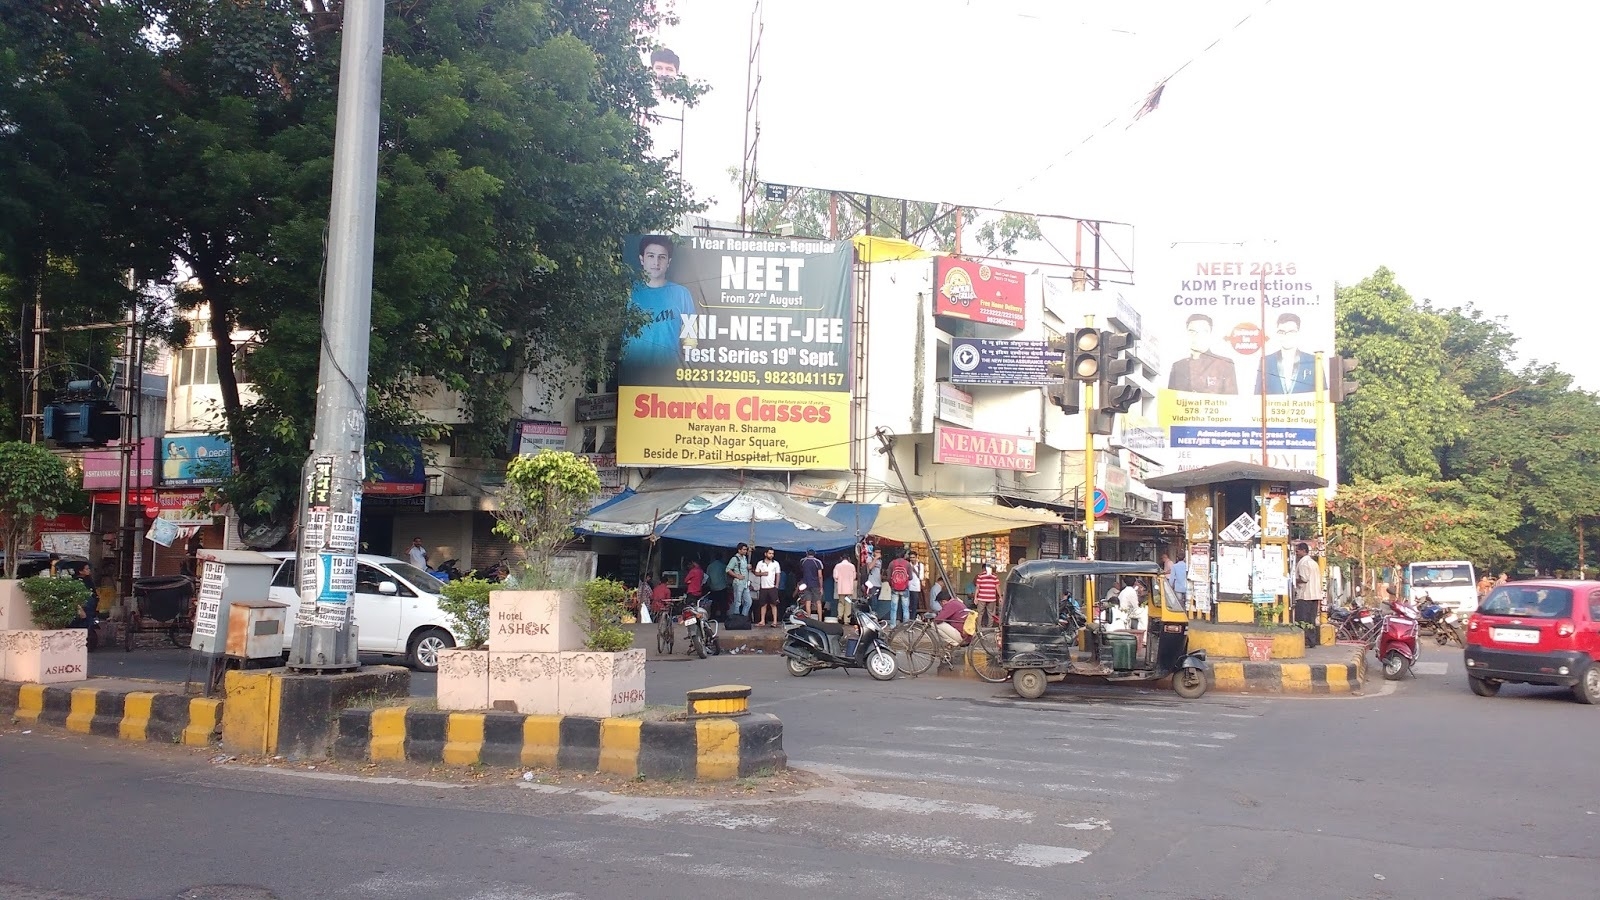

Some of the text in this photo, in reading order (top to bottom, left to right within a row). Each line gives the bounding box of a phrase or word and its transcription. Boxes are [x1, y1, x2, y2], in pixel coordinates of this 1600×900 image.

[691, 237, 836, 254] 1 Year Repeaters-Regular
[720, 256, 805, 292] NEET
[1196, 262, 1297, 276] NEET 2016
[1182, 280, 1313, 291] KDM Predictions
[721, 292, 803, 308] From 22nd August
[1173, 294, 1218, 306] Come
[1223, 294, 1256, 305] True
[1005, 304, 1022, 314] Delivery
[680, 314, 843, 344] XII-NEET-JEE
[683, 346, 838, 368] Test Series 19th Sept.
[675, 368, 844, 386] 9823132905, 9823041157
[634, 394, 832, 424] Sharda Classes
[523, 425, 567, 434] PATHOLOGY LABORATORY
[688, 422, 776, 434] Narayan R. Sharma
[675, 434, 788, 449] Pratap Nagar Square,
[942, 433, 1014, 456] NEMAD
[1212, 438, 1241, 446] Regular
[209, 447, 229, 458] pepsi
[643, 448, 678, 460] Beside
[725, 450, 773, 464] Hospital,
[776, 452, 819, 465] Nagpur.
[975, 454, 1032, 470] FINANCE
[85, 470, 121, 478] ASHTAVINAYAK
[334, 514, 357, 524] TO-LET
[206, 564, 224, 573] TO-LET
[333, 558, 354, 567] TO-LET
[200, 602, 218, 612] TO-LET
[498, 611, 522, 621] Hotel
[498, 622, 550, 636] ASHOK
[45, 664, 82, 675] ASHOK
[612, 688, 644, 704] ASHOK
